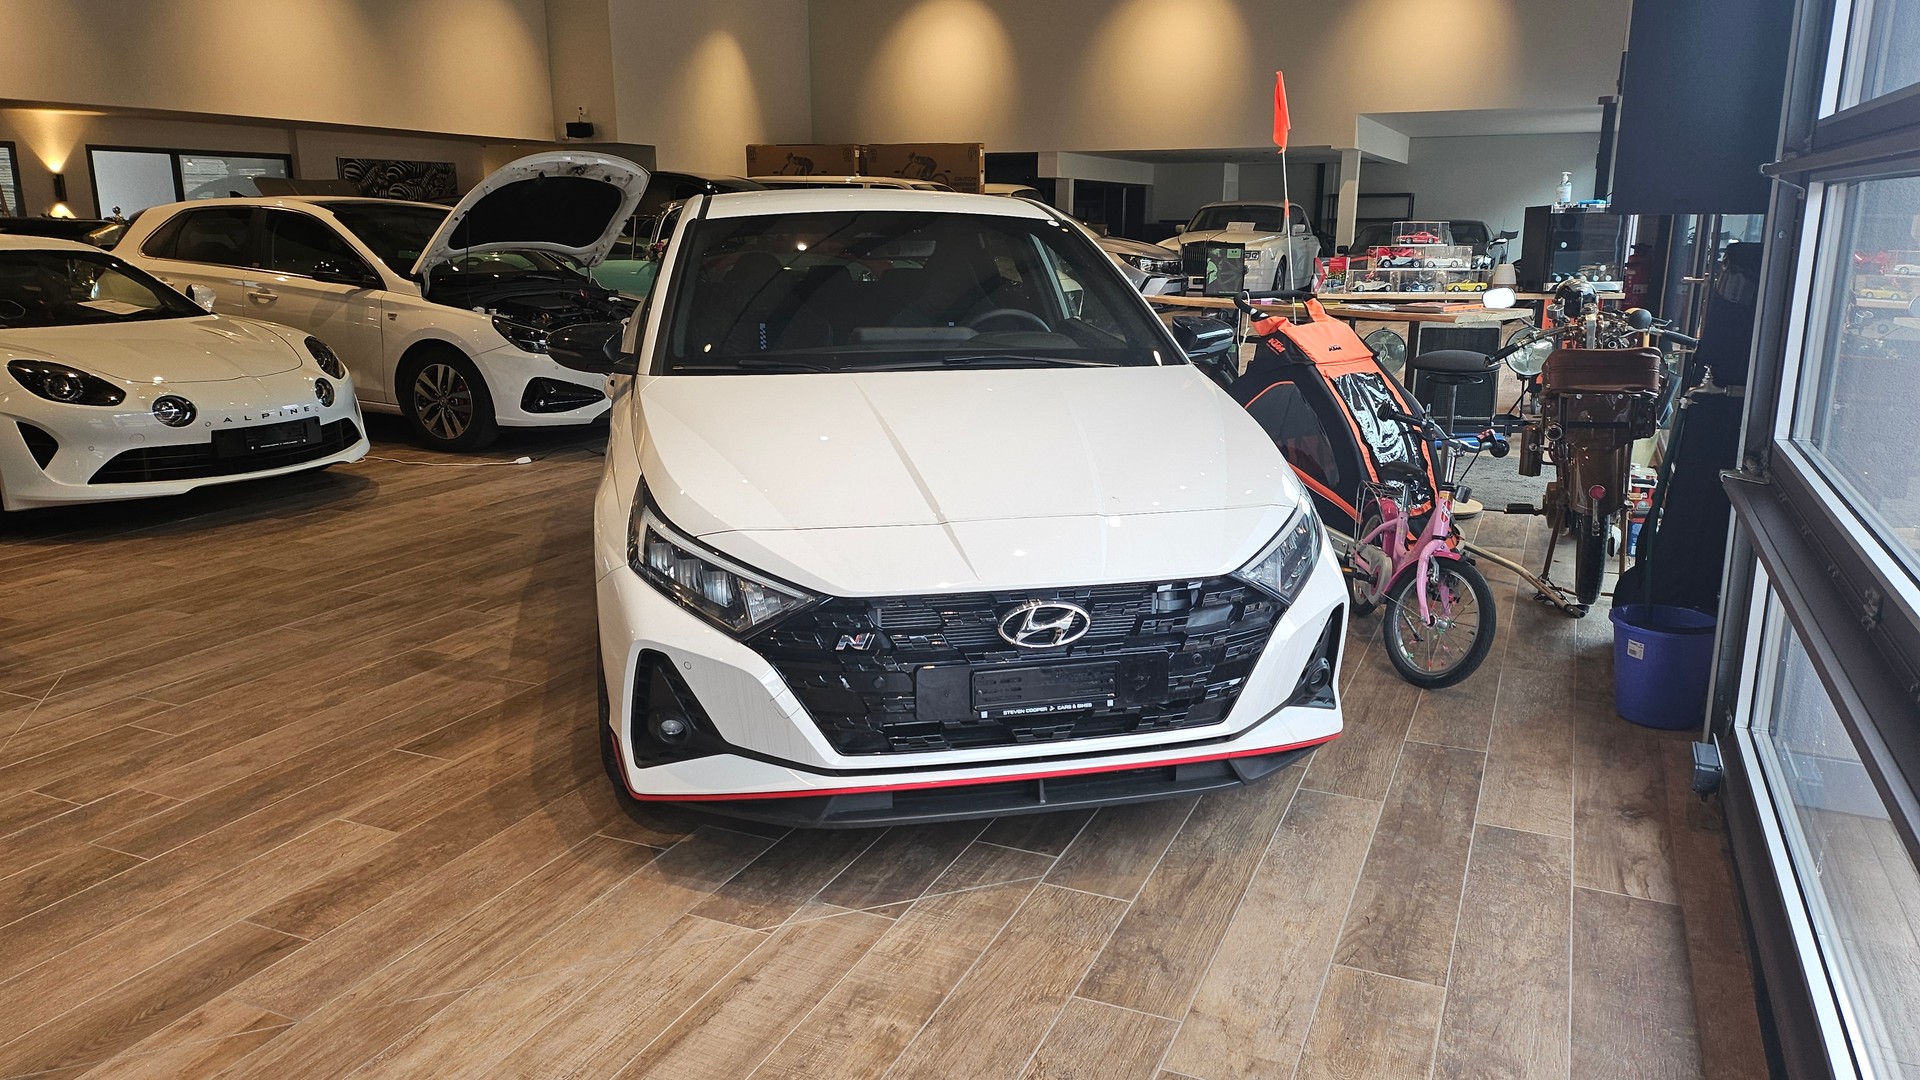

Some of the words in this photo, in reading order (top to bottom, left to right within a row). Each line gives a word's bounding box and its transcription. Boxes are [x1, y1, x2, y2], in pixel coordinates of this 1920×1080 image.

[1267, 337, 1286, 353] KTM
[223, 406, 310, 423] ALPINE
[1025, 706, 1048, 714] COOPER
